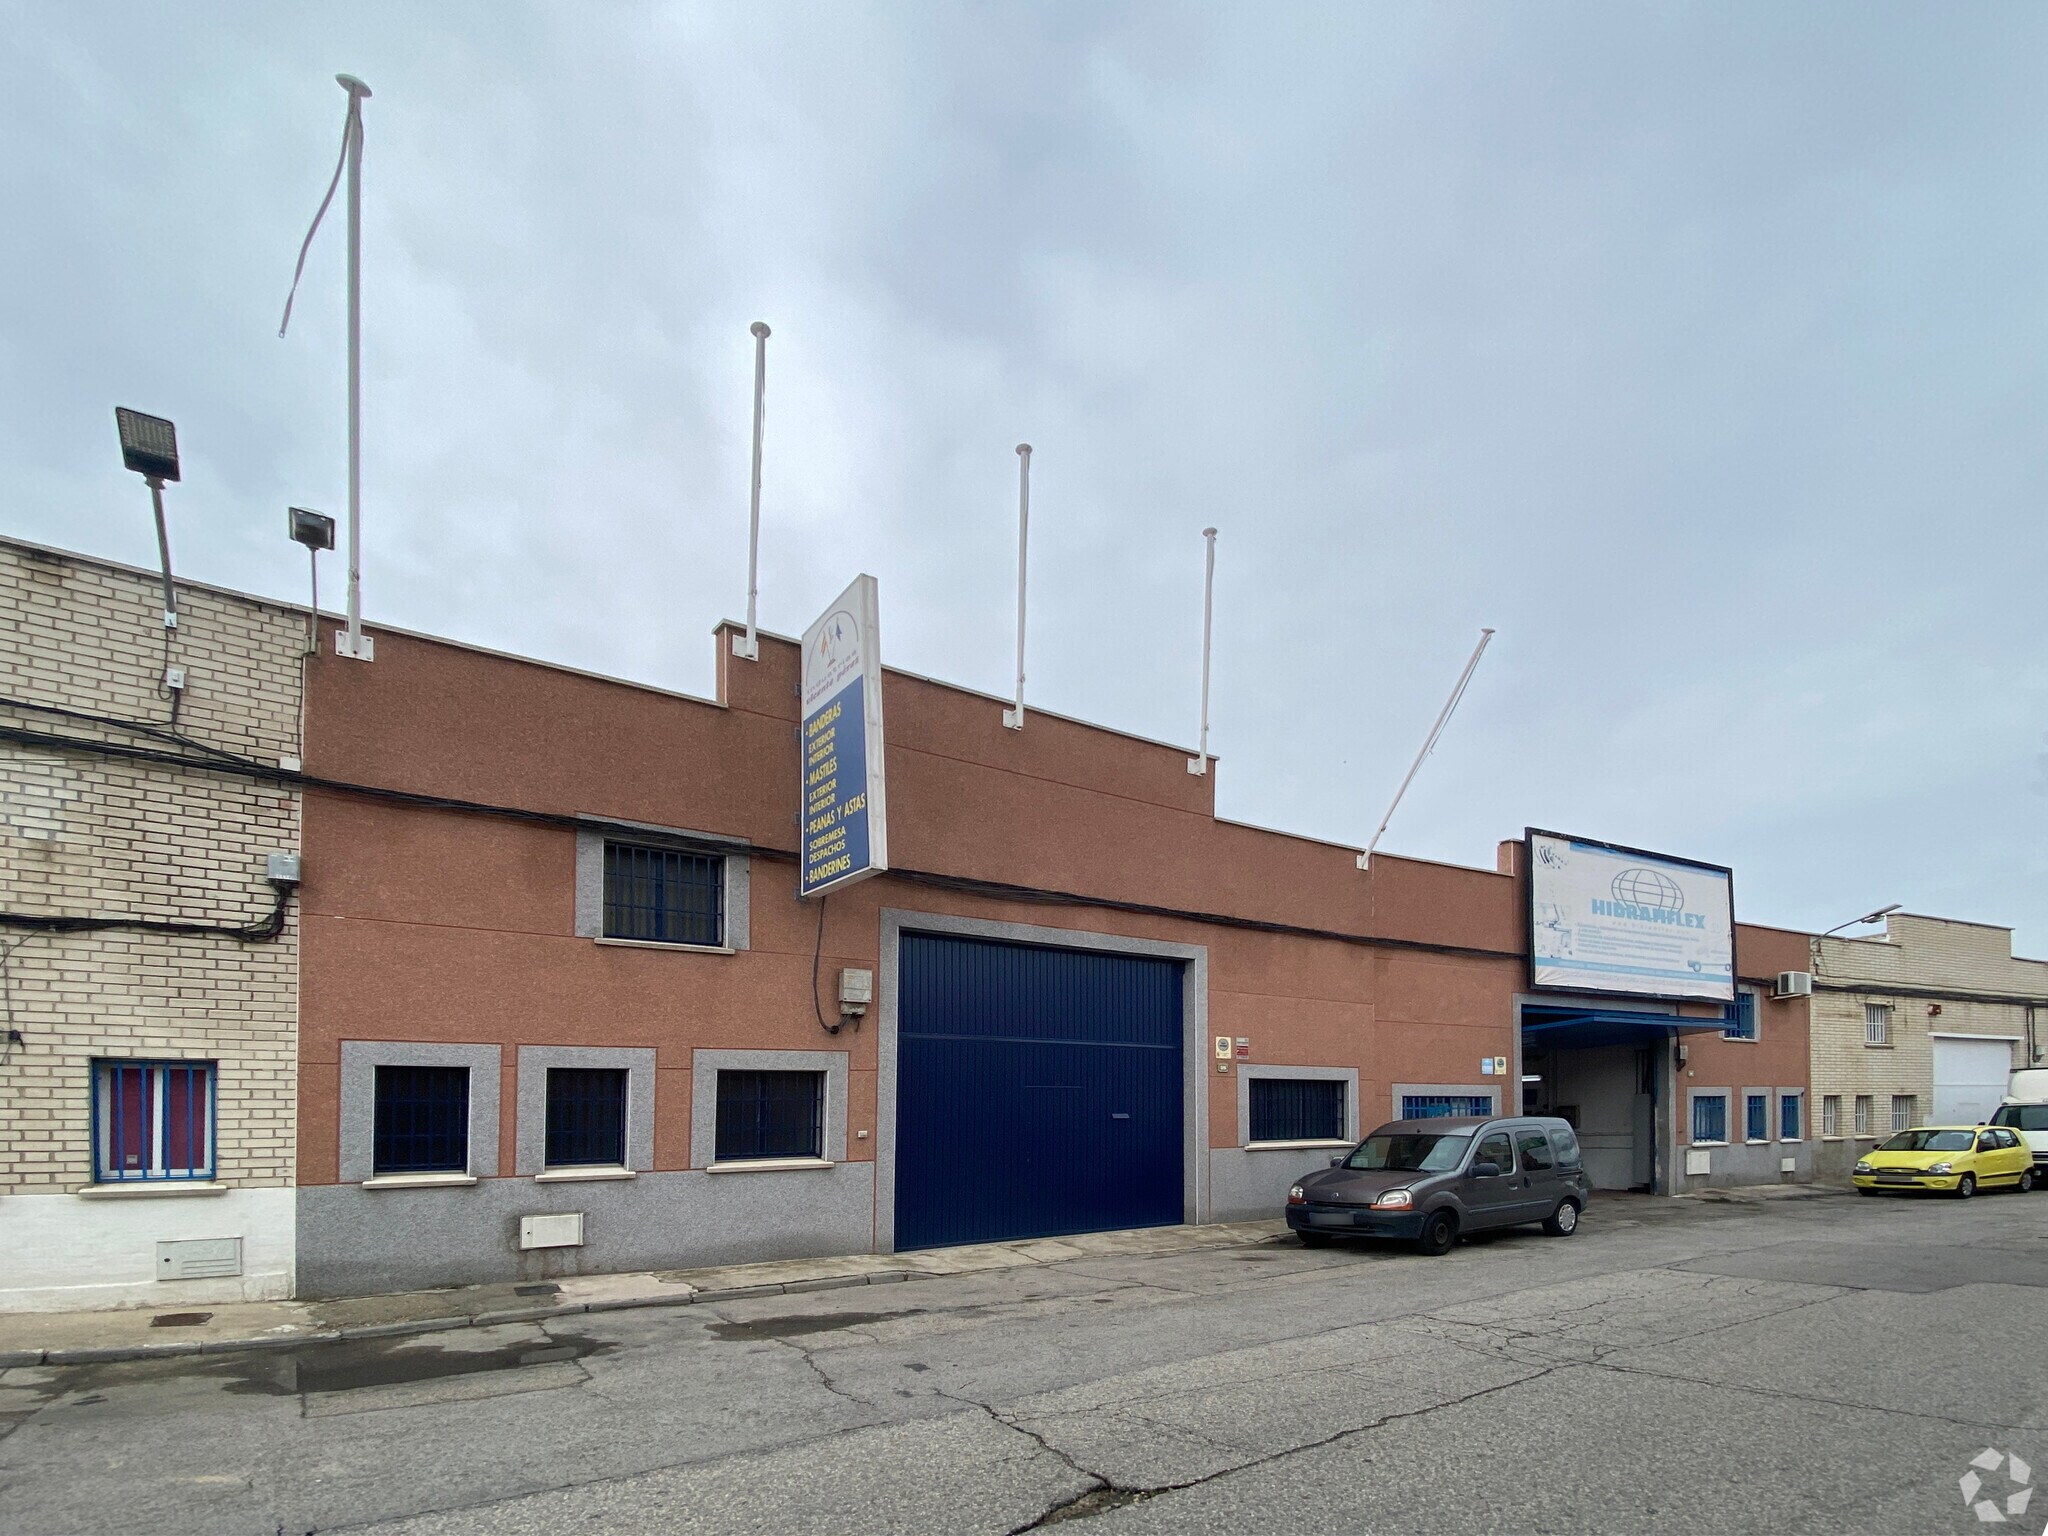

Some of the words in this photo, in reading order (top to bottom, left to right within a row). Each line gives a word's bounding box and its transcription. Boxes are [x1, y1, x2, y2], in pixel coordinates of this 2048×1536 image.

[808, 701, 842, 738] BANDERAS
[808, 726, 836, 754] EXTERIOR
[808, 741, 834, 767] INTERIOR
[808, 756, 838, 787] MASTILES
[808, 778, 837, 803] EXTERIOR
[808, 792, 836, 816] INTERIOR
[809, 809, 836, 836] PEANAS
[836, 805, 842, 821] Y
[843, 792, 867, 818] ASTAS
[808, 825, 847, 852] SOBREMESA
[808, 838, 846, 864] DESPACHOS
[808, 853, 851, 884] BANDERINES
